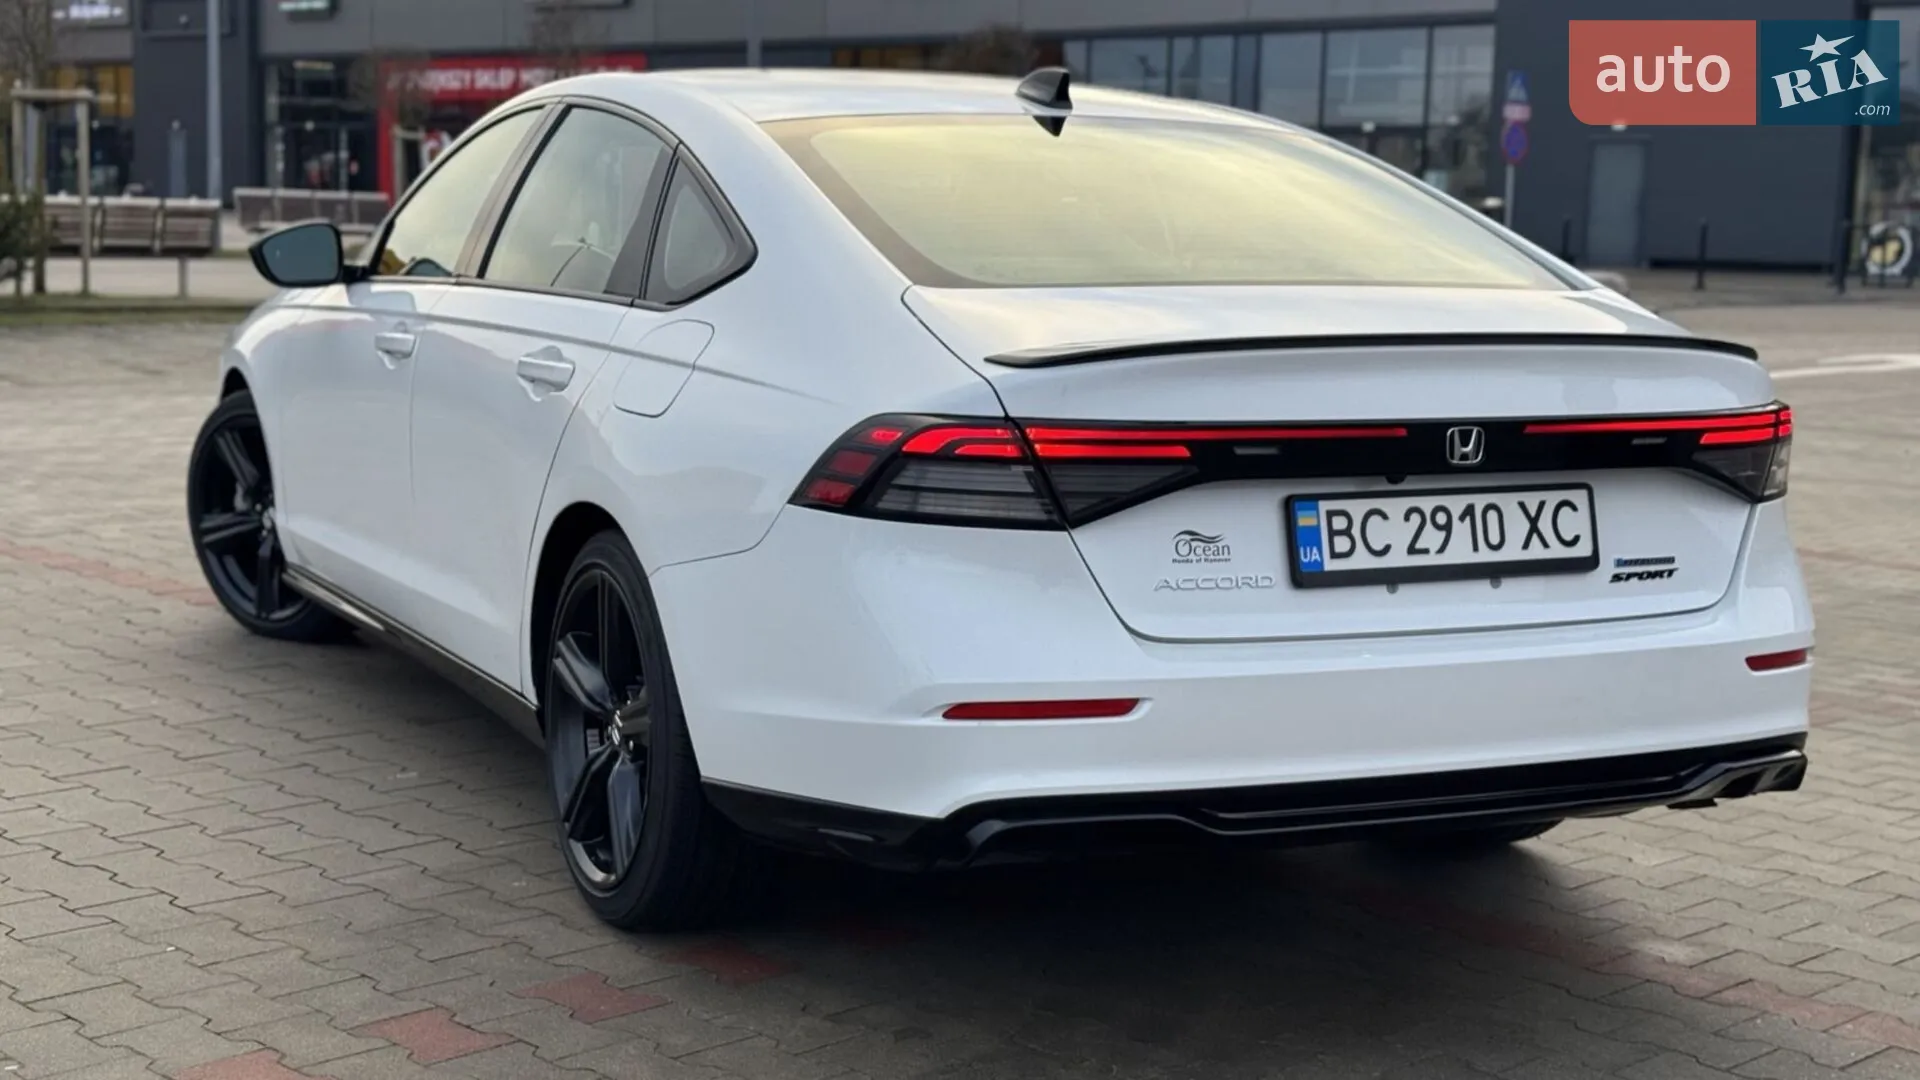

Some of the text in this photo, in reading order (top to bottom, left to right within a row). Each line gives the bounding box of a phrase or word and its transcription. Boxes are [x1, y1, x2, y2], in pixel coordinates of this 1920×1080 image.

[1325, 498, 1581, 560] BC 2910 XC
[1174, 538, 1232, 558] Ocean
[1301, 545, 1321, 563] UA
[1153, 574, 1277, 592] ACCORD
[1608, 566, 1680, 584] SPORT
